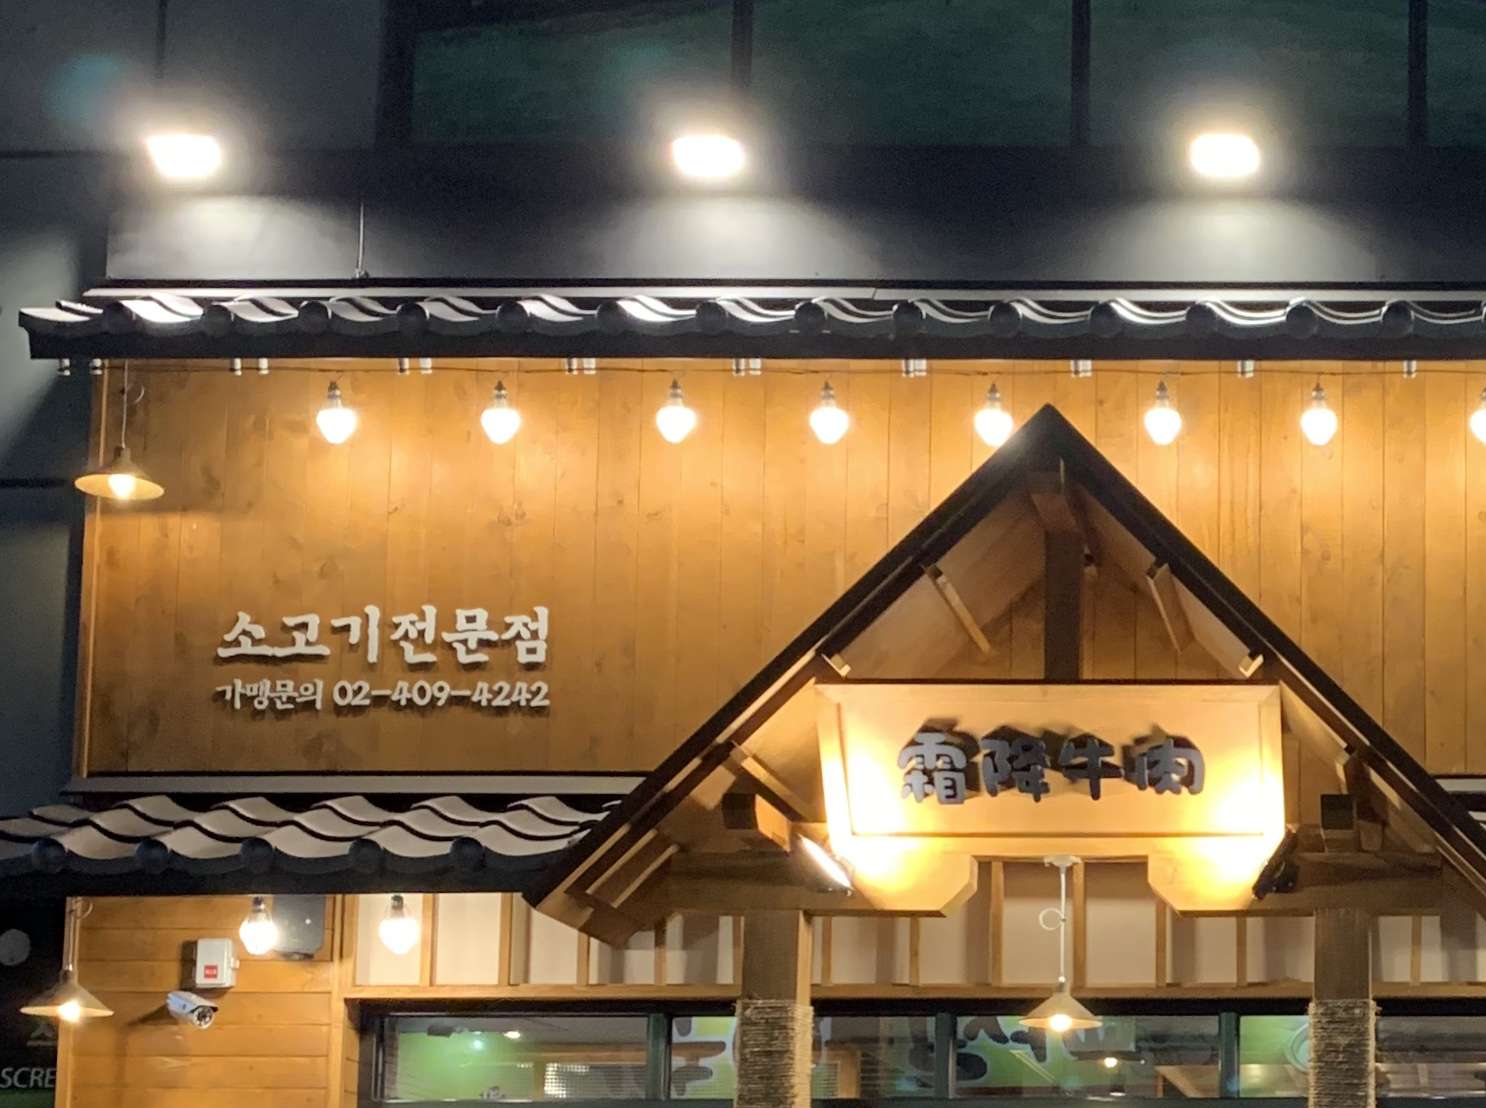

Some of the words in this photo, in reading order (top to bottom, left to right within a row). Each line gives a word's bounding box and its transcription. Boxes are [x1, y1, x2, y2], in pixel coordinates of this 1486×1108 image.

[216, 604, 549, 664] 소고기전문점
[215, 678, 324, 710] 가맹문의
[332, 679, 550, 707] 02-409-4242
[897, 730, 1206, 805] 霜降牛肉
[0, 1066, 57, 1089] SCRE
